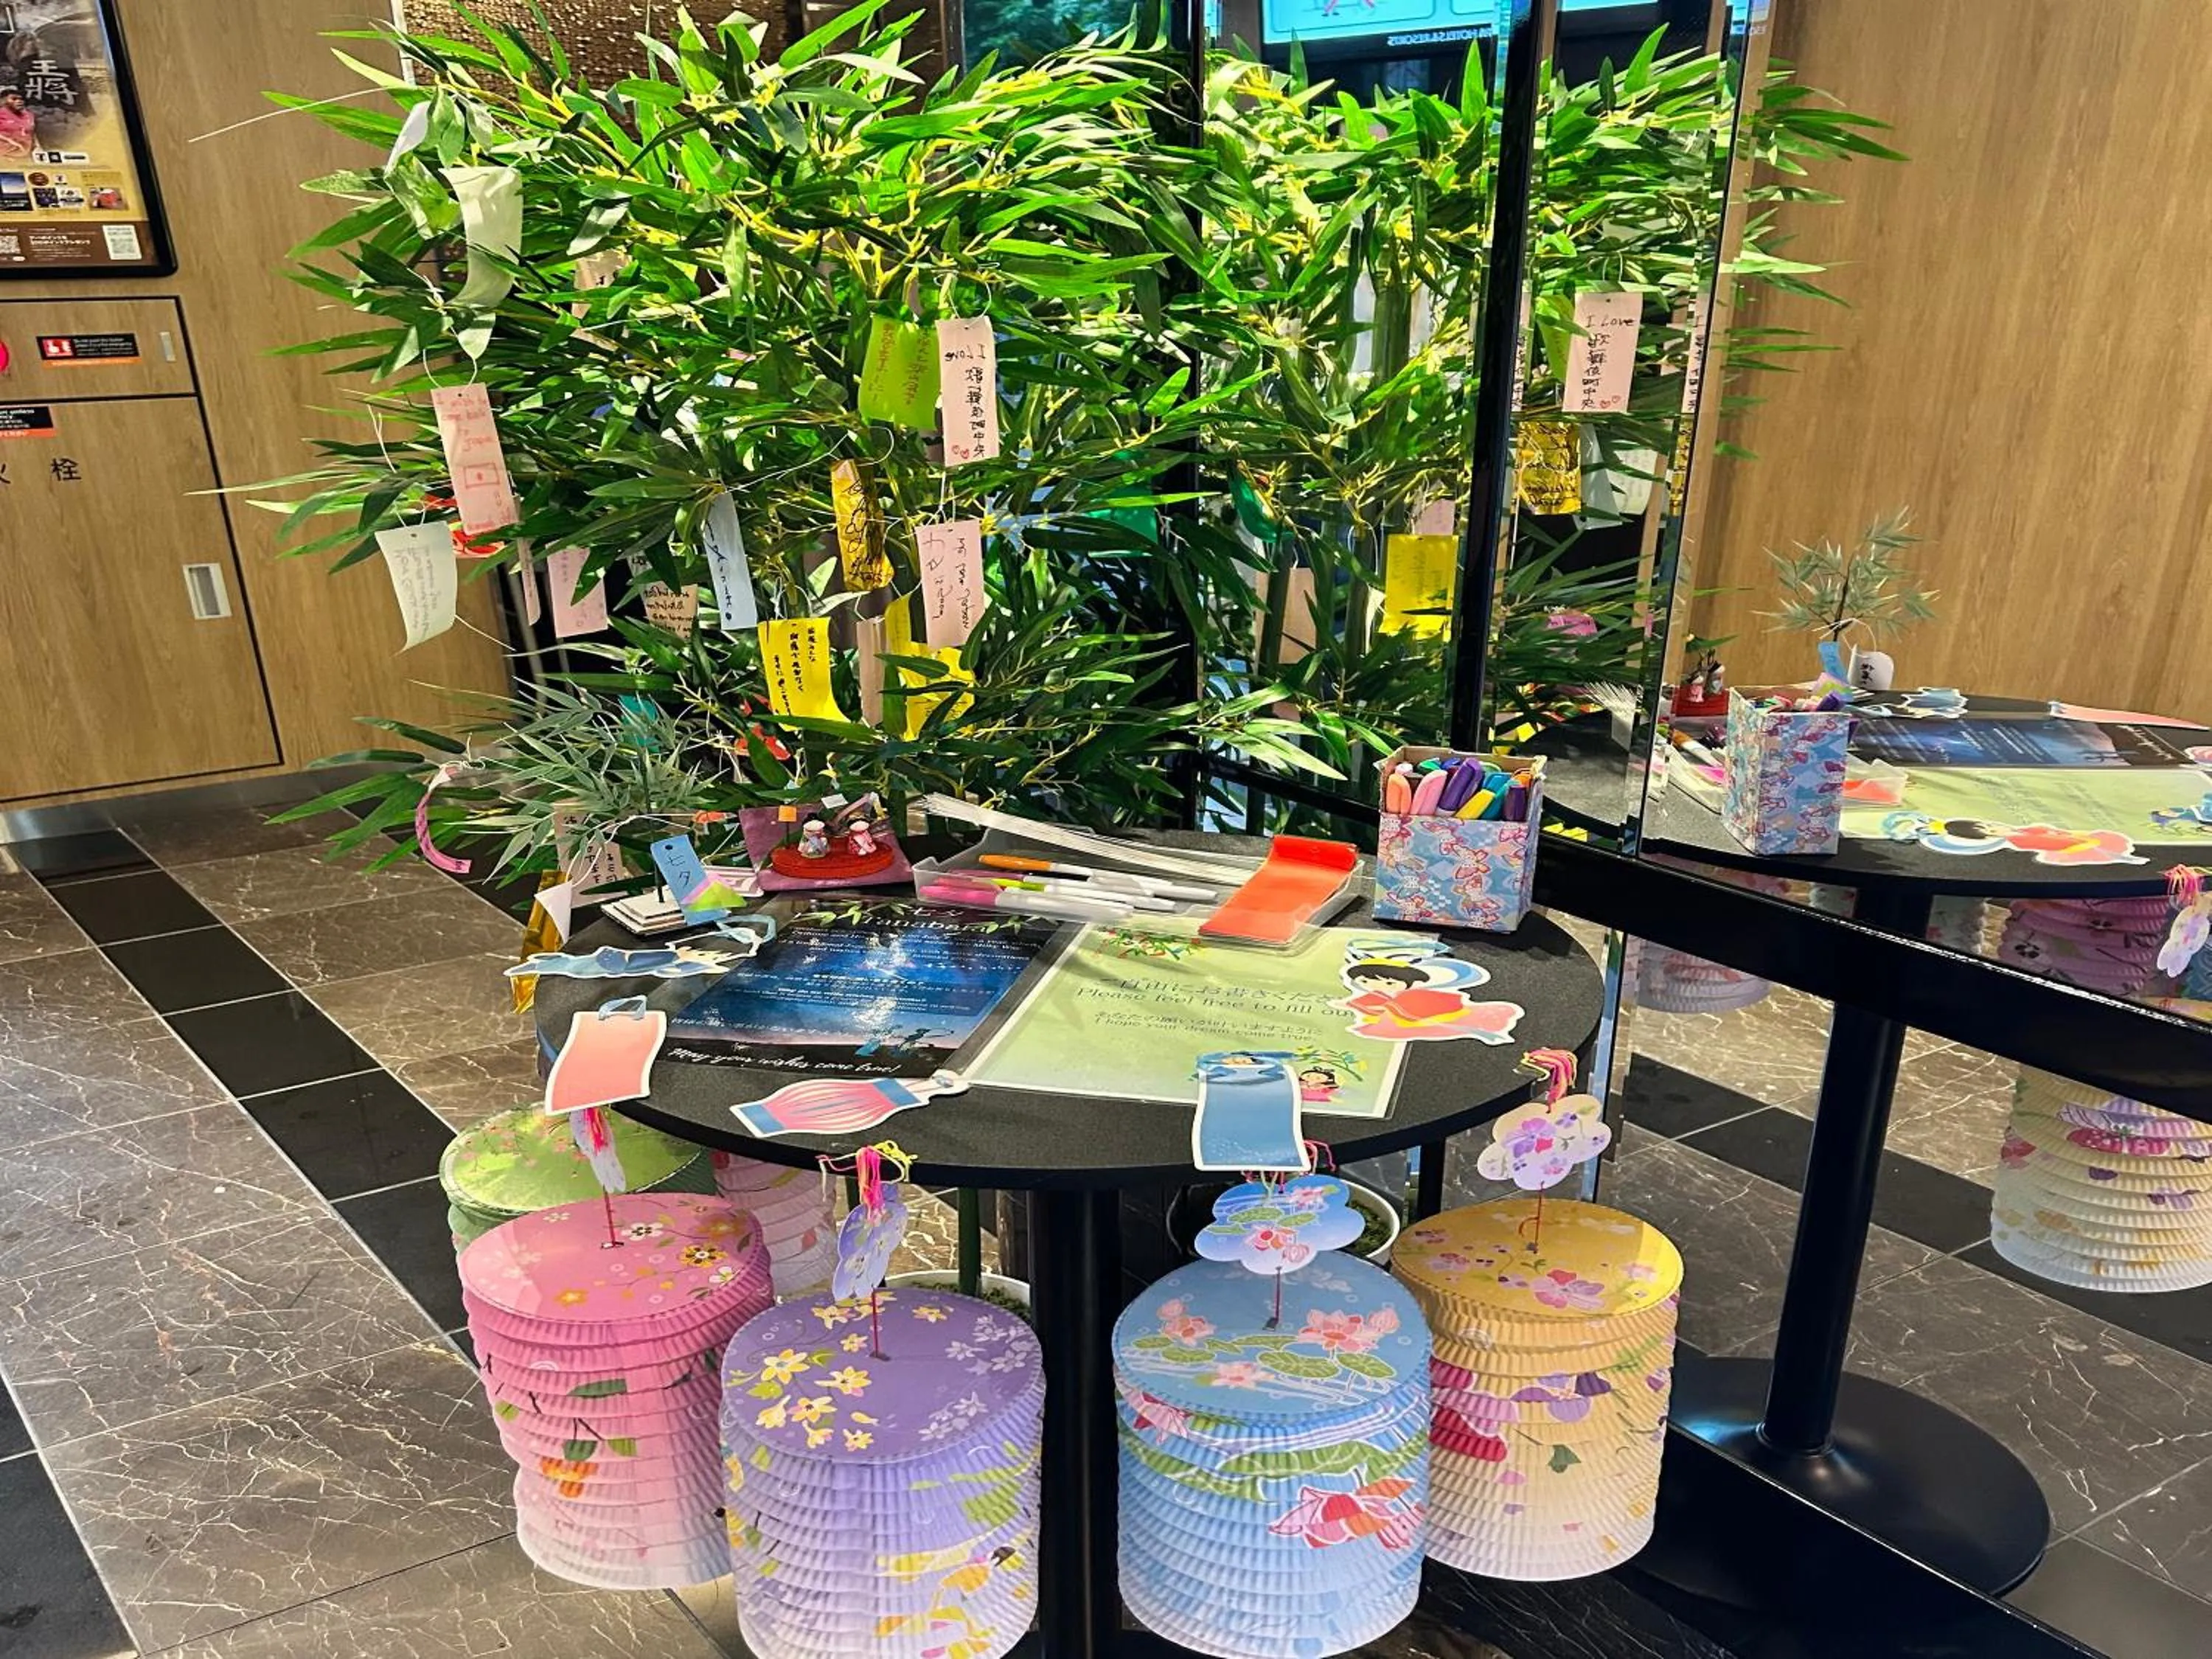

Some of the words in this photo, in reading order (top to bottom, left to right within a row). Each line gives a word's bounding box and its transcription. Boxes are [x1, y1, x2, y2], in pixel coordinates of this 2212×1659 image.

[667, 852, 692, 888] 七夕
[1077, 987, 1146, 1000] Please
[1155, 994, 1194, 1004] feel
[1203, 998, 1244, 1008] free
[1254, 1002, 1276, 1011] to
